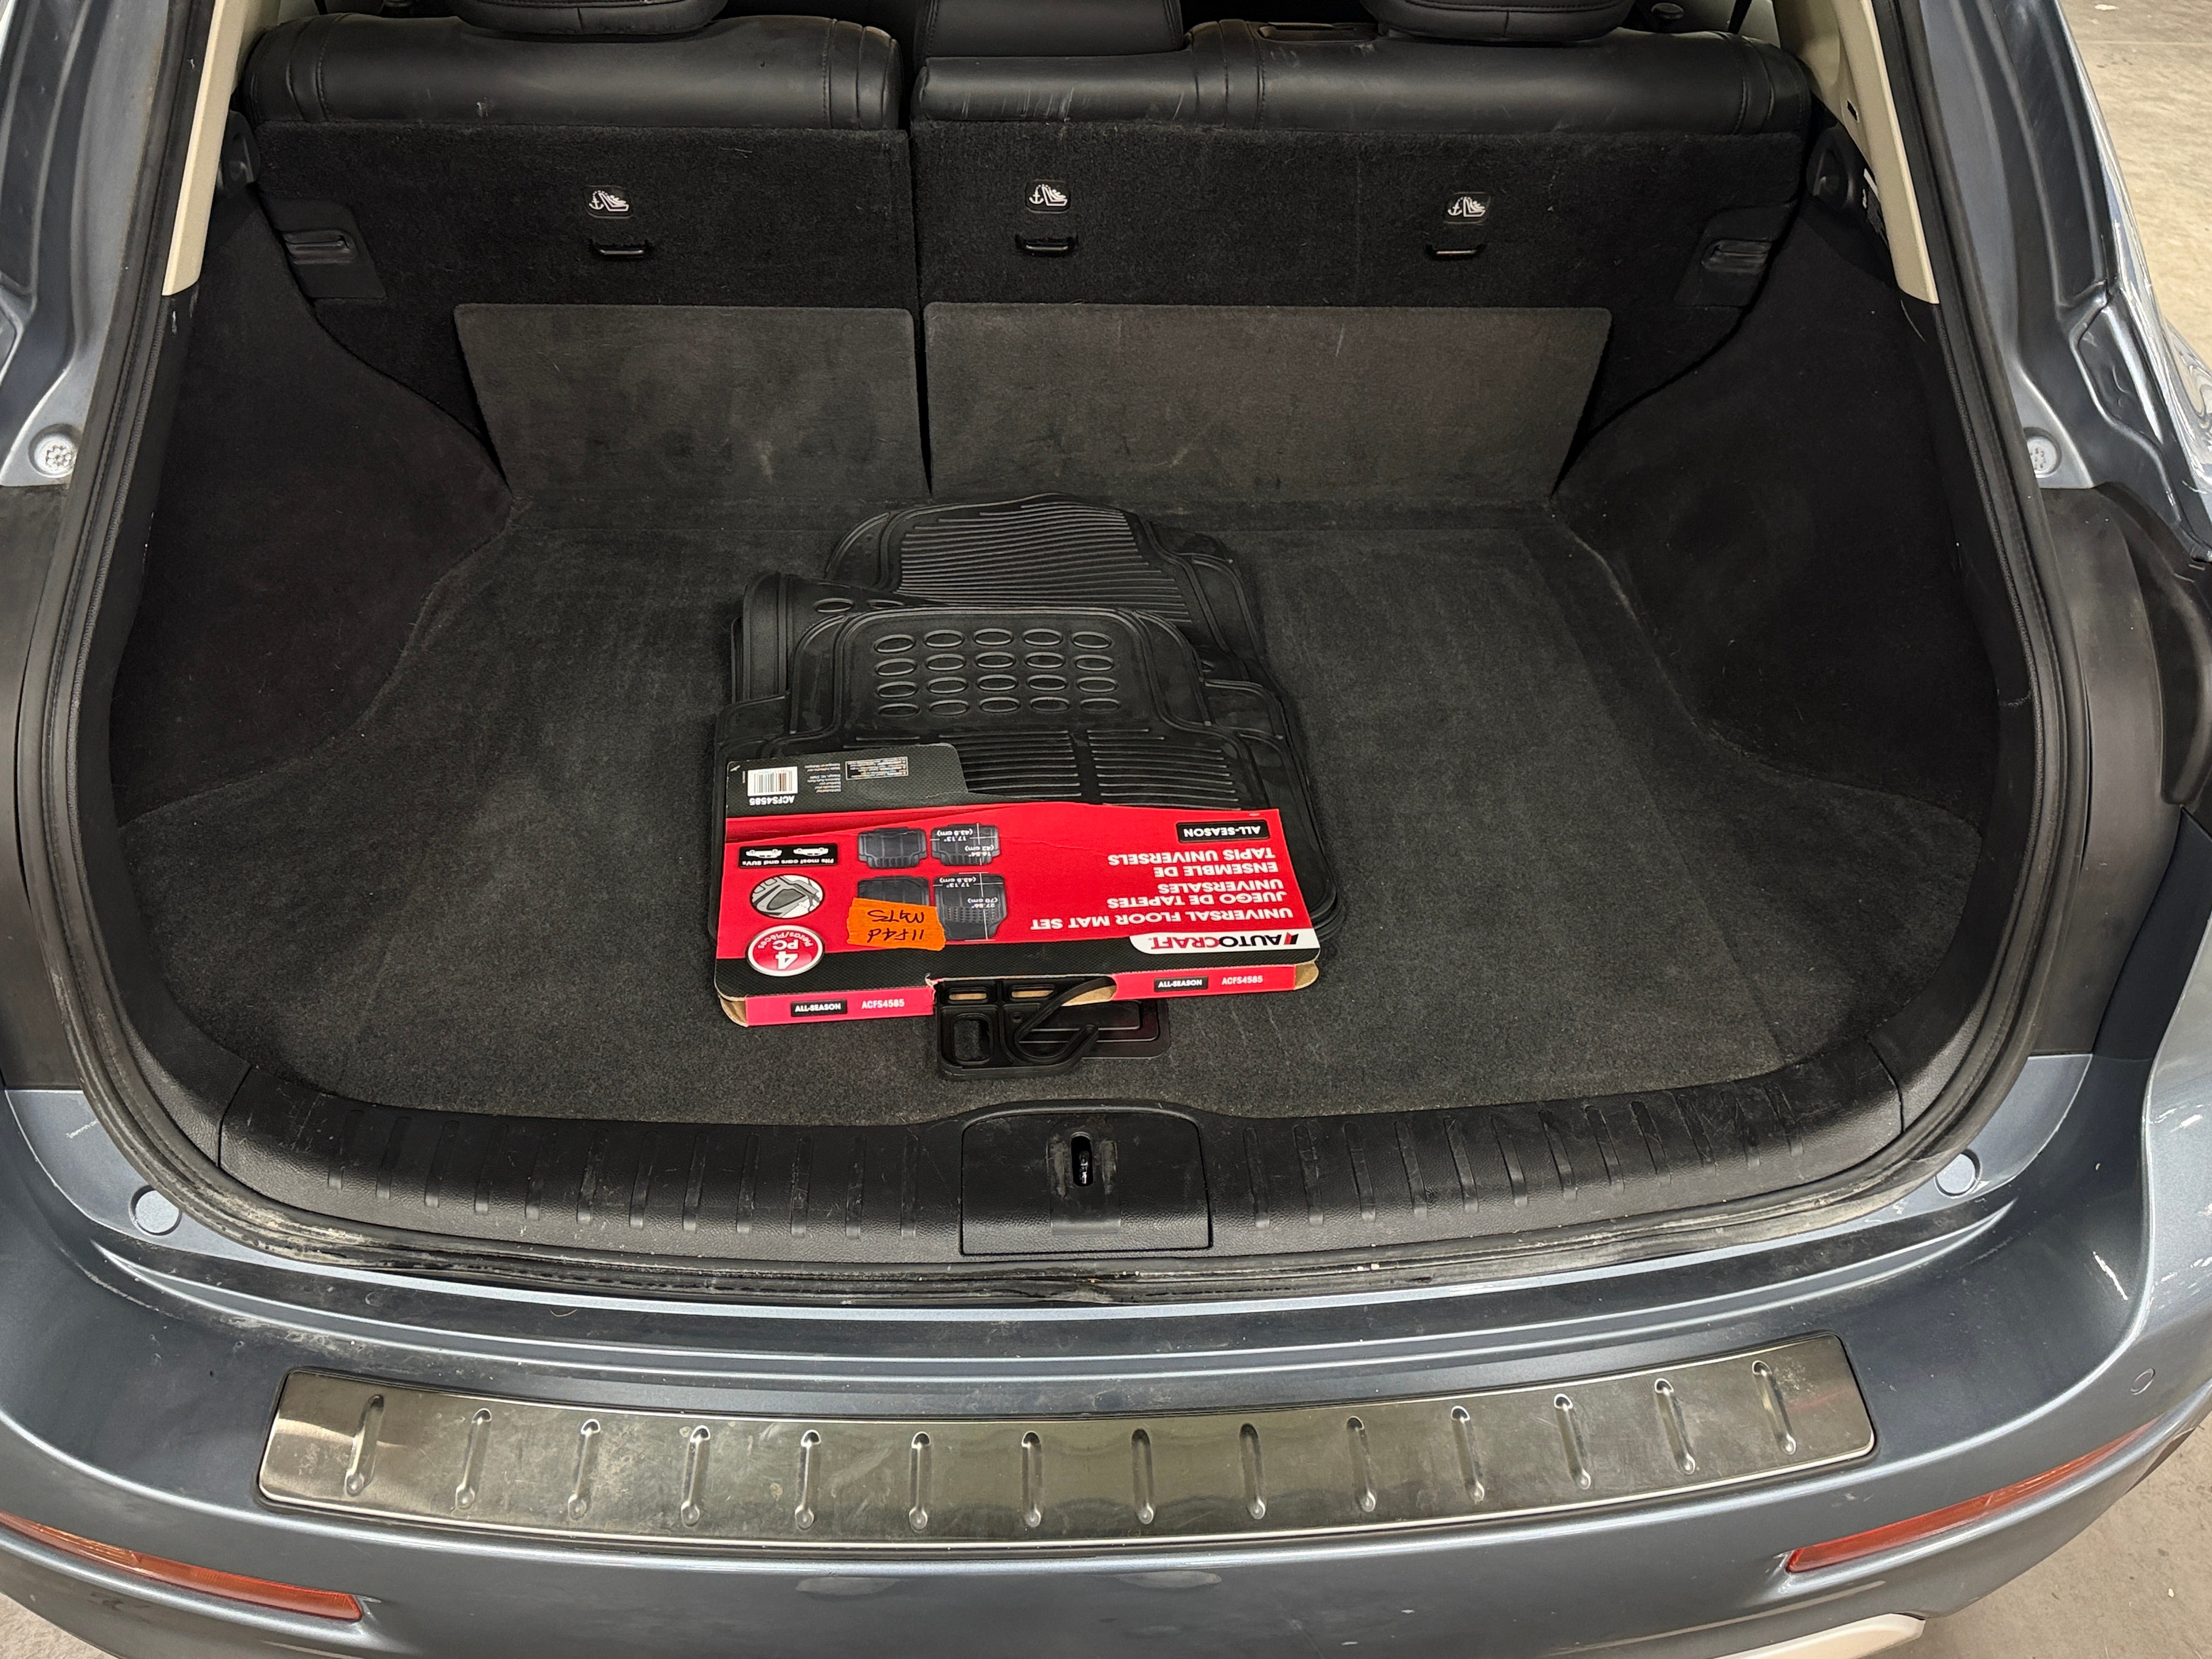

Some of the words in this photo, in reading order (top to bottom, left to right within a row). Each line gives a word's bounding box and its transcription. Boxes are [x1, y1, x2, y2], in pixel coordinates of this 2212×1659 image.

[749, 795, 795, 805] ACFS4585
[1183, 826, 1261, 837] ALL-SEASON
[1108, 850, 1218, 866] UNIVERSELS
[1222, 847, 1276, 861] TAPIS
[1153, 867, 1178, 878] DE
[1182, 862, 1279, 876] ENSEMBLE
[1158, 879, 1284, 894] UNIVERSALES
[1107, 895, 1186, 909] TAPETES
[1188, 894, 1215, 905] DE
[1219, 891, 1287, 904] JUEGO
[1115, 912, 1181, 925] FLOOR
[1185, 908, 1294, 922] UNIVERSAL
[1030, 918, 1063, 930] SET
[1068, 916, 1110, 928] MAT
[772, 939, 799, 950] PC
[1151, 935, 1282, 950] AUTOCRAFT
[775, 951, 798, 969] 4
[1158, 979, 1203, 988] ALL-SEASON
[1221, 975, 1263, 985] ACFS4585
[795, 1003, 841, 1012] ALL-SEASON
[861, 998, 905, 1009] ACFS4585
